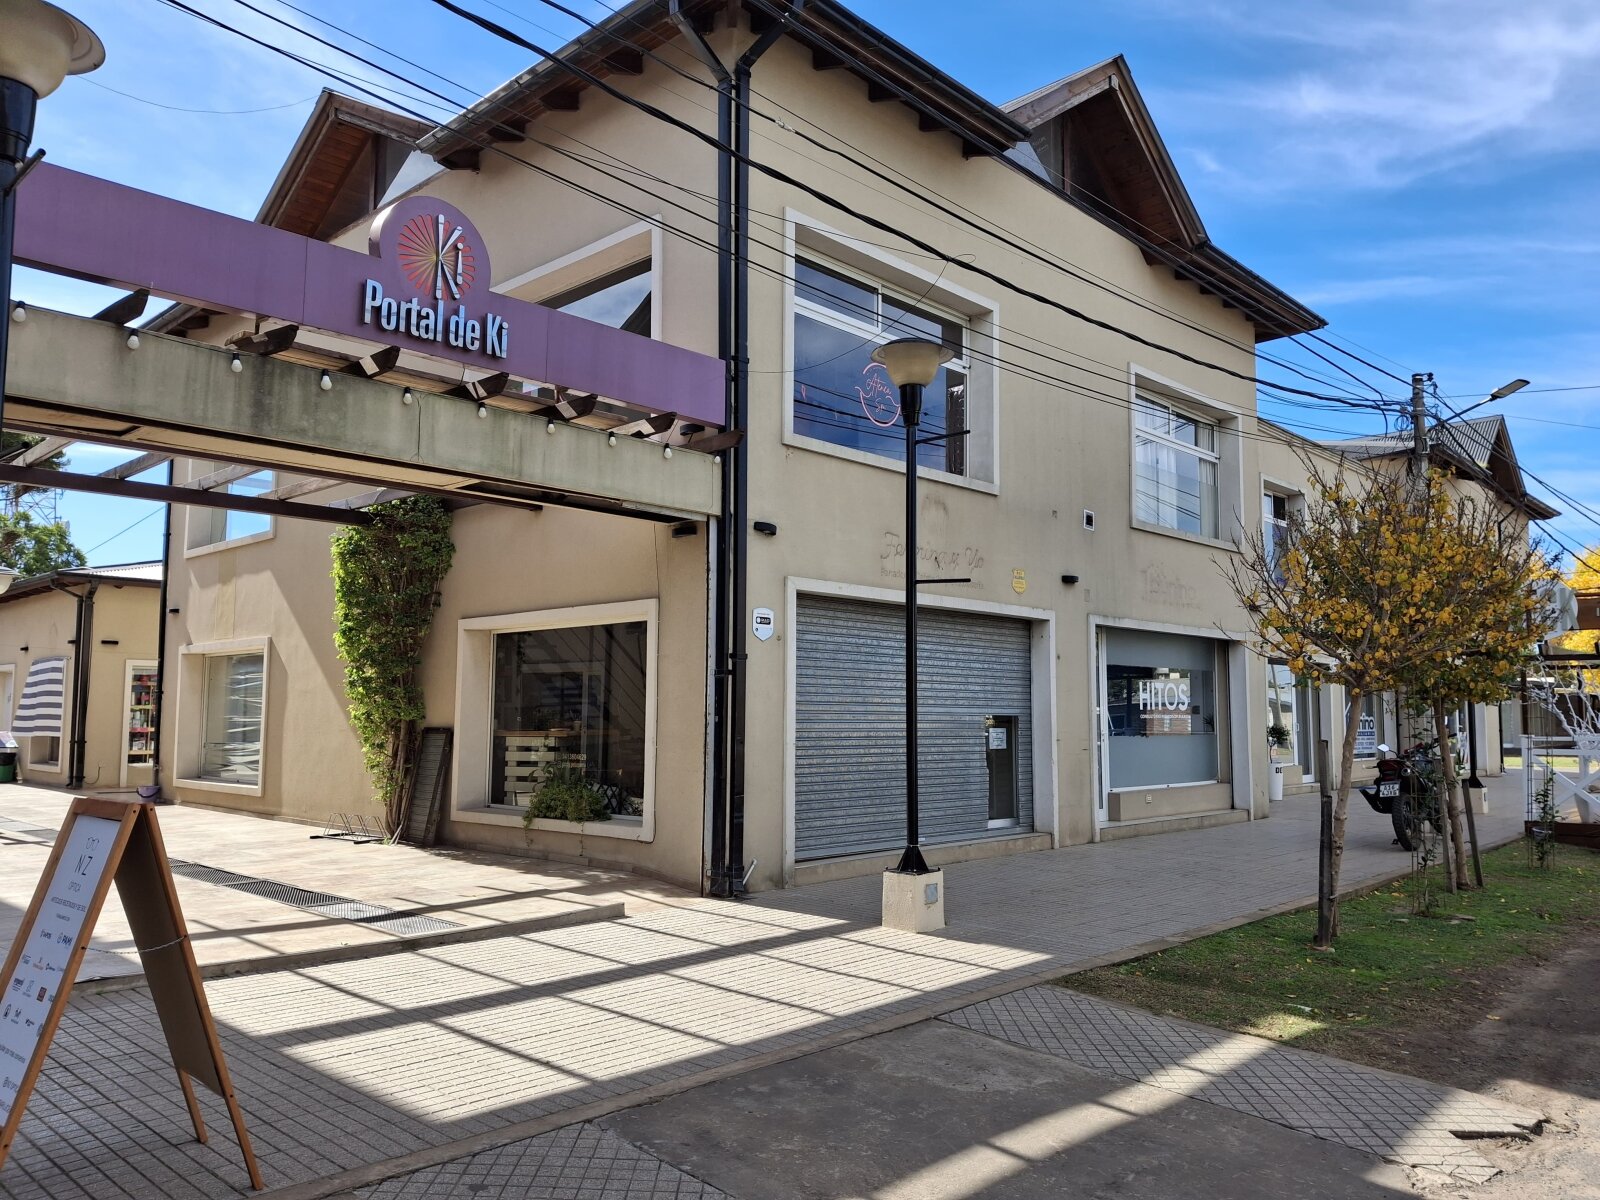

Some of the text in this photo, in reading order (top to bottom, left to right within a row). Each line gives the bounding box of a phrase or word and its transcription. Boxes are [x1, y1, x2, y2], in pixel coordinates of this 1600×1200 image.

[364, 278, 509, 359] Portal de Ki
[1139, 681, 1188, 711] HITOS
[74, 854, 93, 876] NZ
